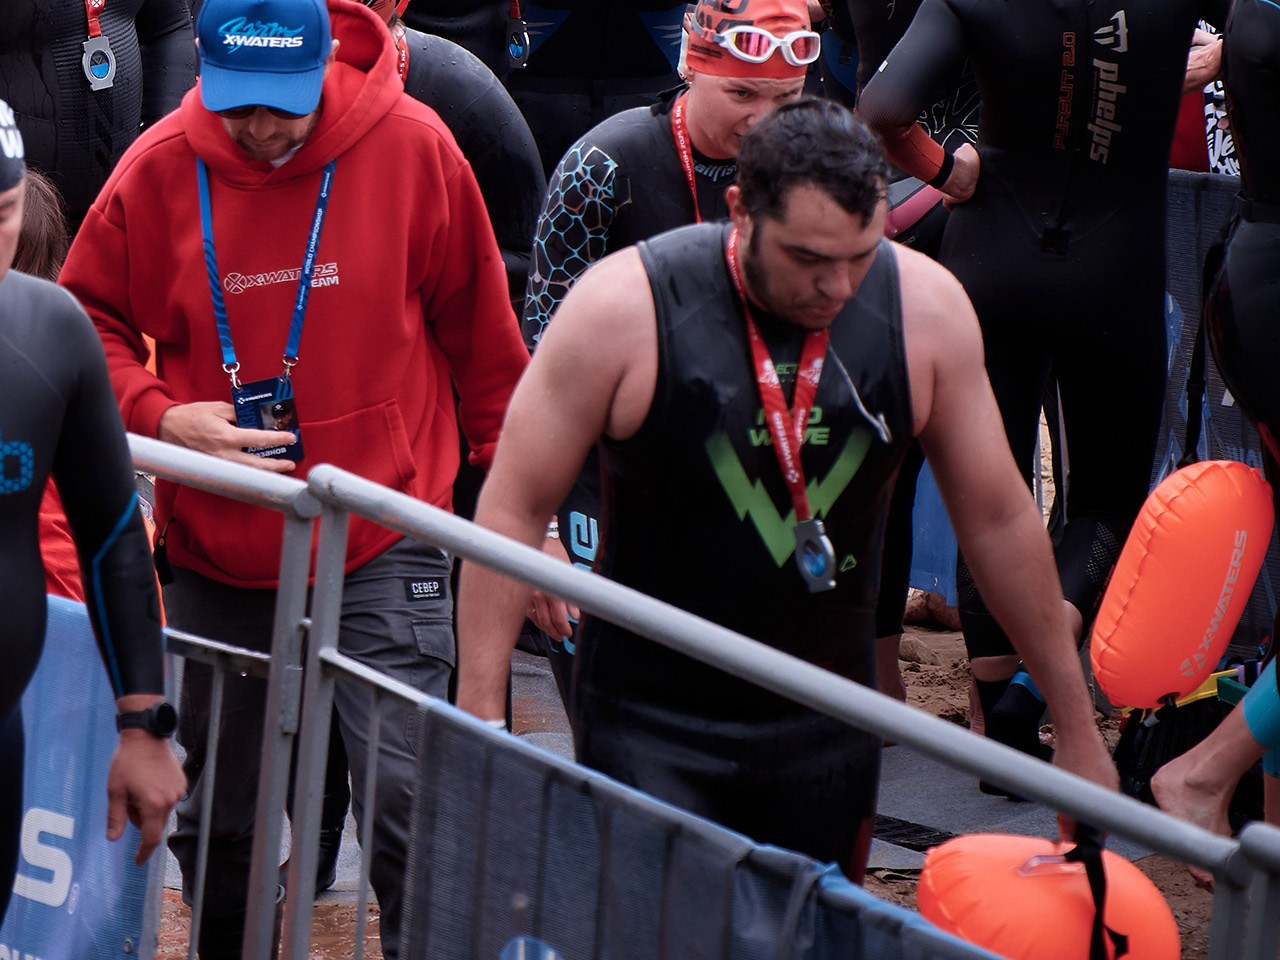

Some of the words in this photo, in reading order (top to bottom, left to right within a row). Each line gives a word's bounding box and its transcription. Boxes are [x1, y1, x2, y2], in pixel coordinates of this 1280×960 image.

[1062, 31, 1076, 67] 2.0
[1052, 70, 1074, 149] PURSUIT
[1086, 58, 1127, 165] phelps
[304, 253, 314, 274] WORLD
[310, 208, 323, 253] CHAMPIONSHIP
[311, 275, 340, 288] EAM
